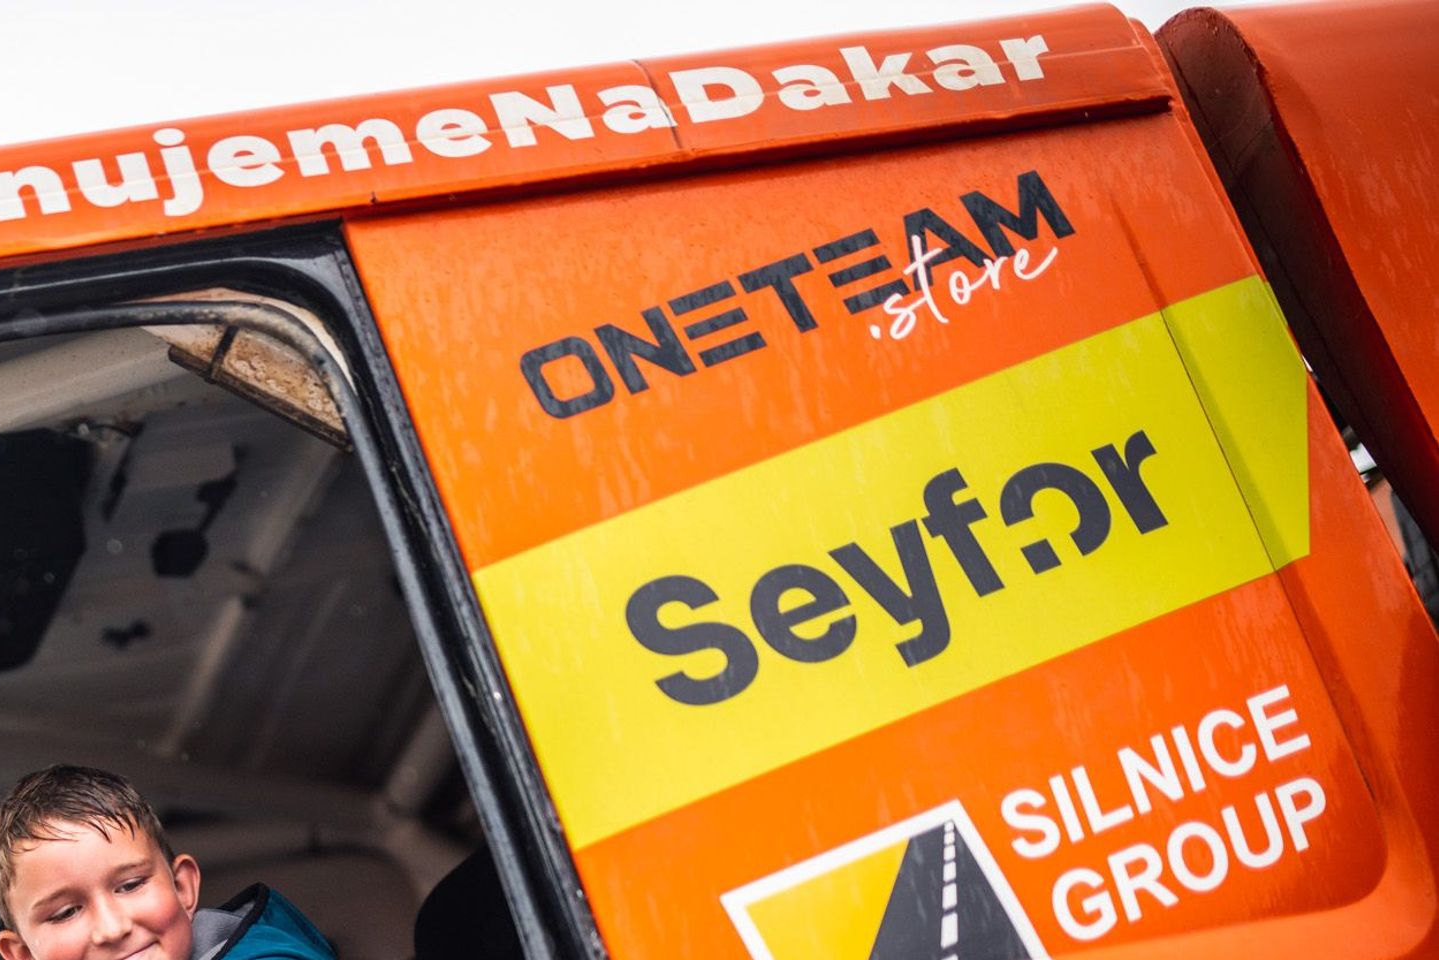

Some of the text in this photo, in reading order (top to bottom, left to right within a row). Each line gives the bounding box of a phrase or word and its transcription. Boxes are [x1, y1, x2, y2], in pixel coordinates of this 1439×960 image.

[520, 169, 1076, 420] ONETEAM
[625, 429, 1170, 706] Seyfor
[1001, 684, 1312, 859] SILNICE
[1052, 777, 1327, 942] GROUP
